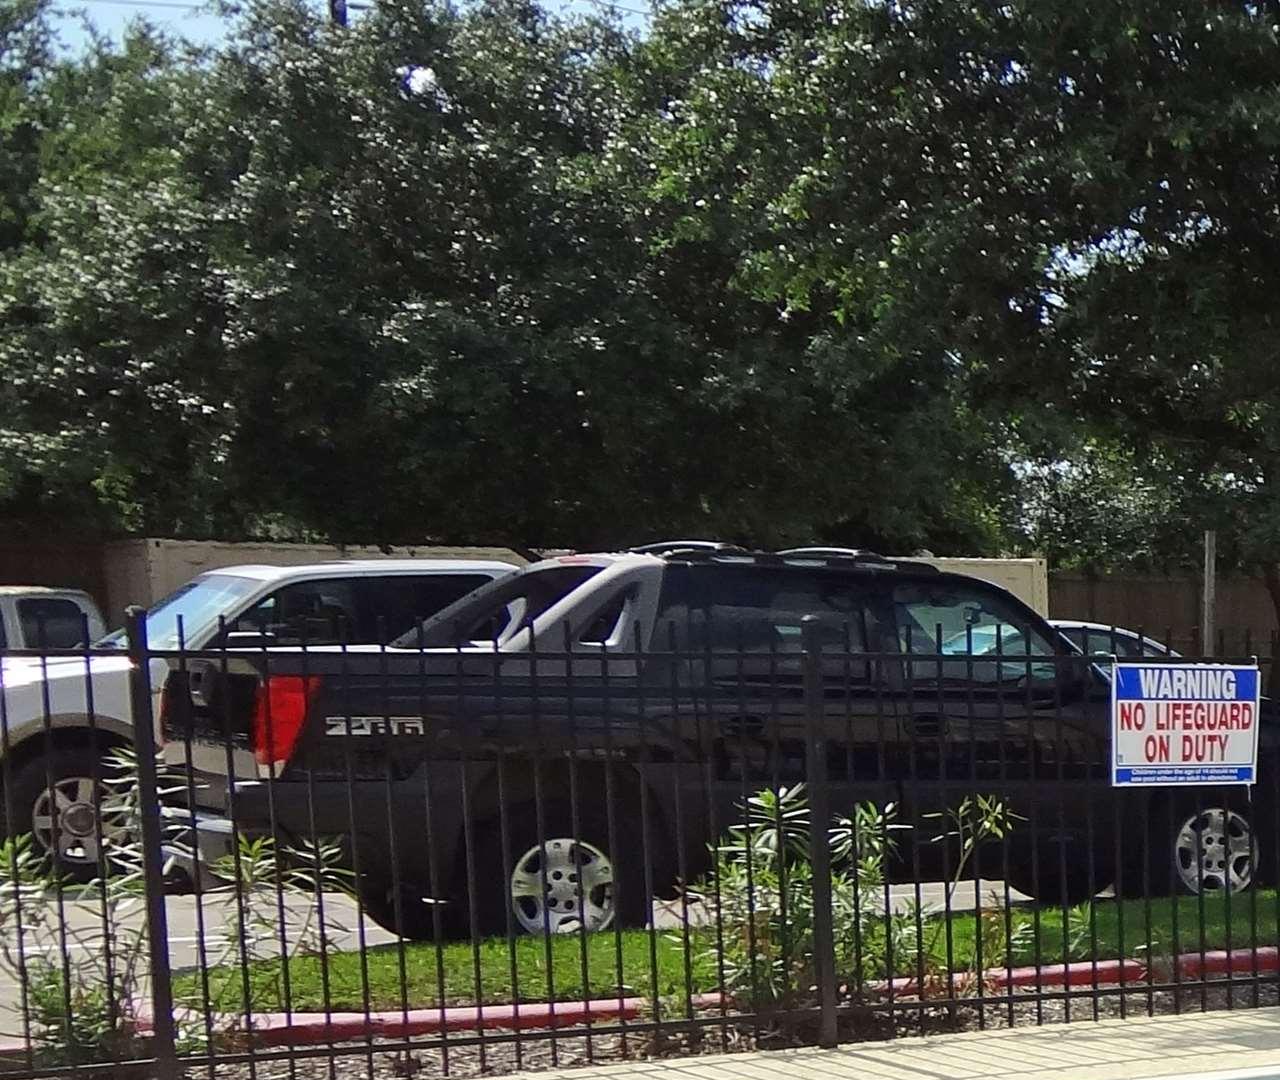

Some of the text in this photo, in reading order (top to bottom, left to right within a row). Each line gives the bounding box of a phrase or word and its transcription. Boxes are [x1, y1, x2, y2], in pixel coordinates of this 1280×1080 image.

[1138, 669, 1237, 699] WARNING
[1120, 702, 1252, 731] NO LIFEGUARD
[1144, 734, 1229, 762] ON DUTY
